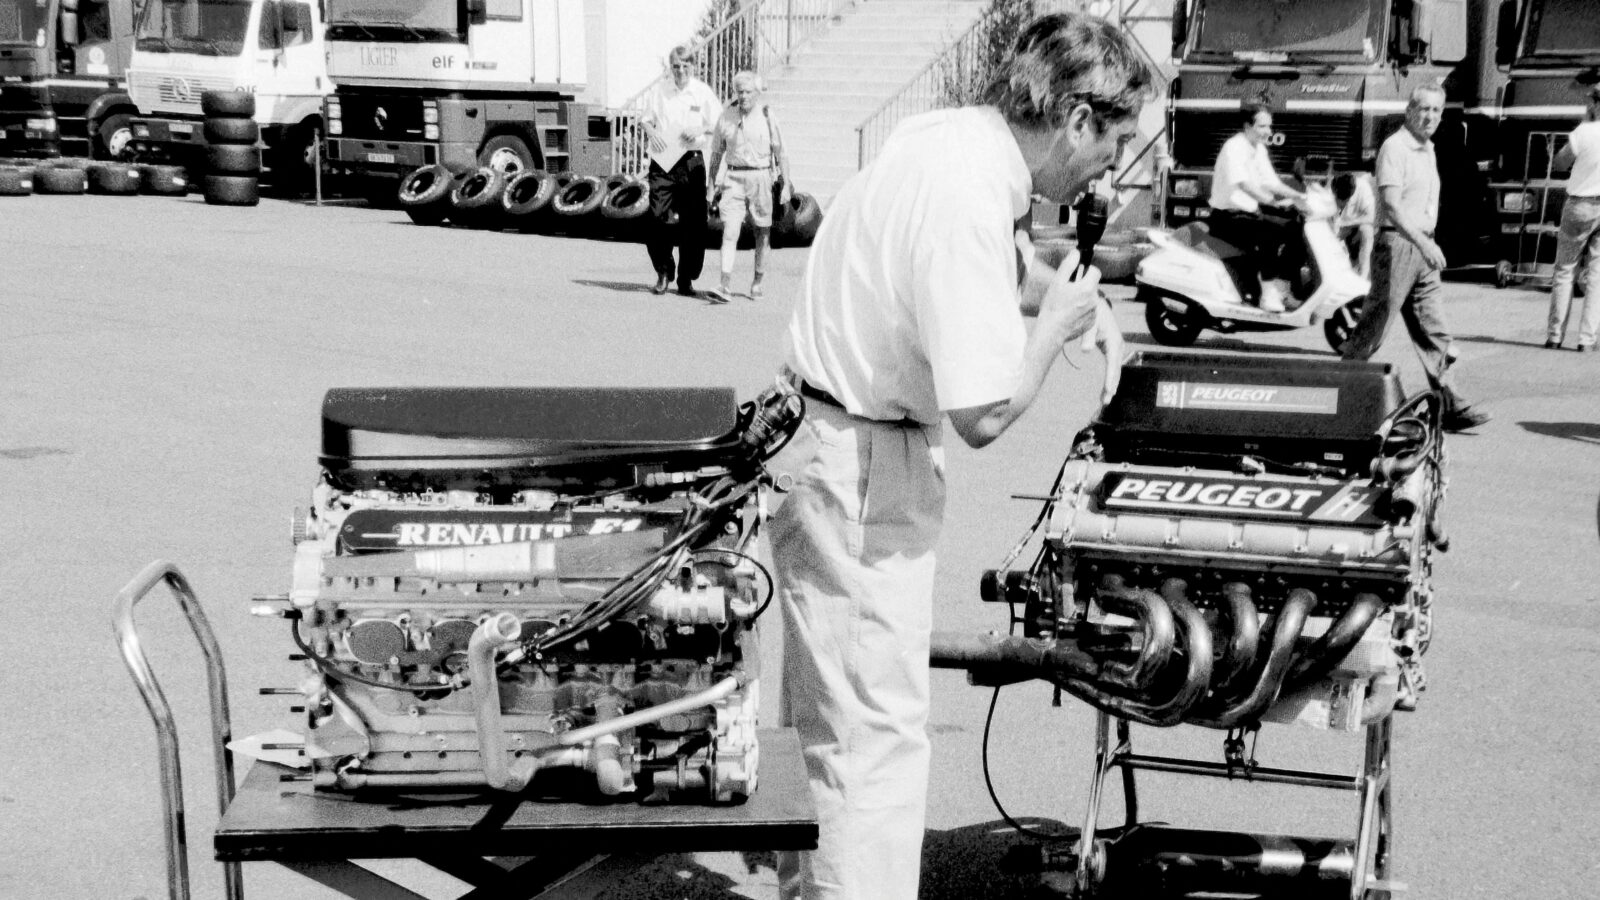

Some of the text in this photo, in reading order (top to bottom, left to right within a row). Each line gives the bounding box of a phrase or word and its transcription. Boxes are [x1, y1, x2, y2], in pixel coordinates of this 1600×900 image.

[361, 47, 397, 66] LIGIER
[432, 56, 454, 68] elf
[1191, 387, 1278, 402] PEUGEOT
[1111, 478, 1322, 510] PEUGEOT
[397, 523, 572, 545] RENAULT
